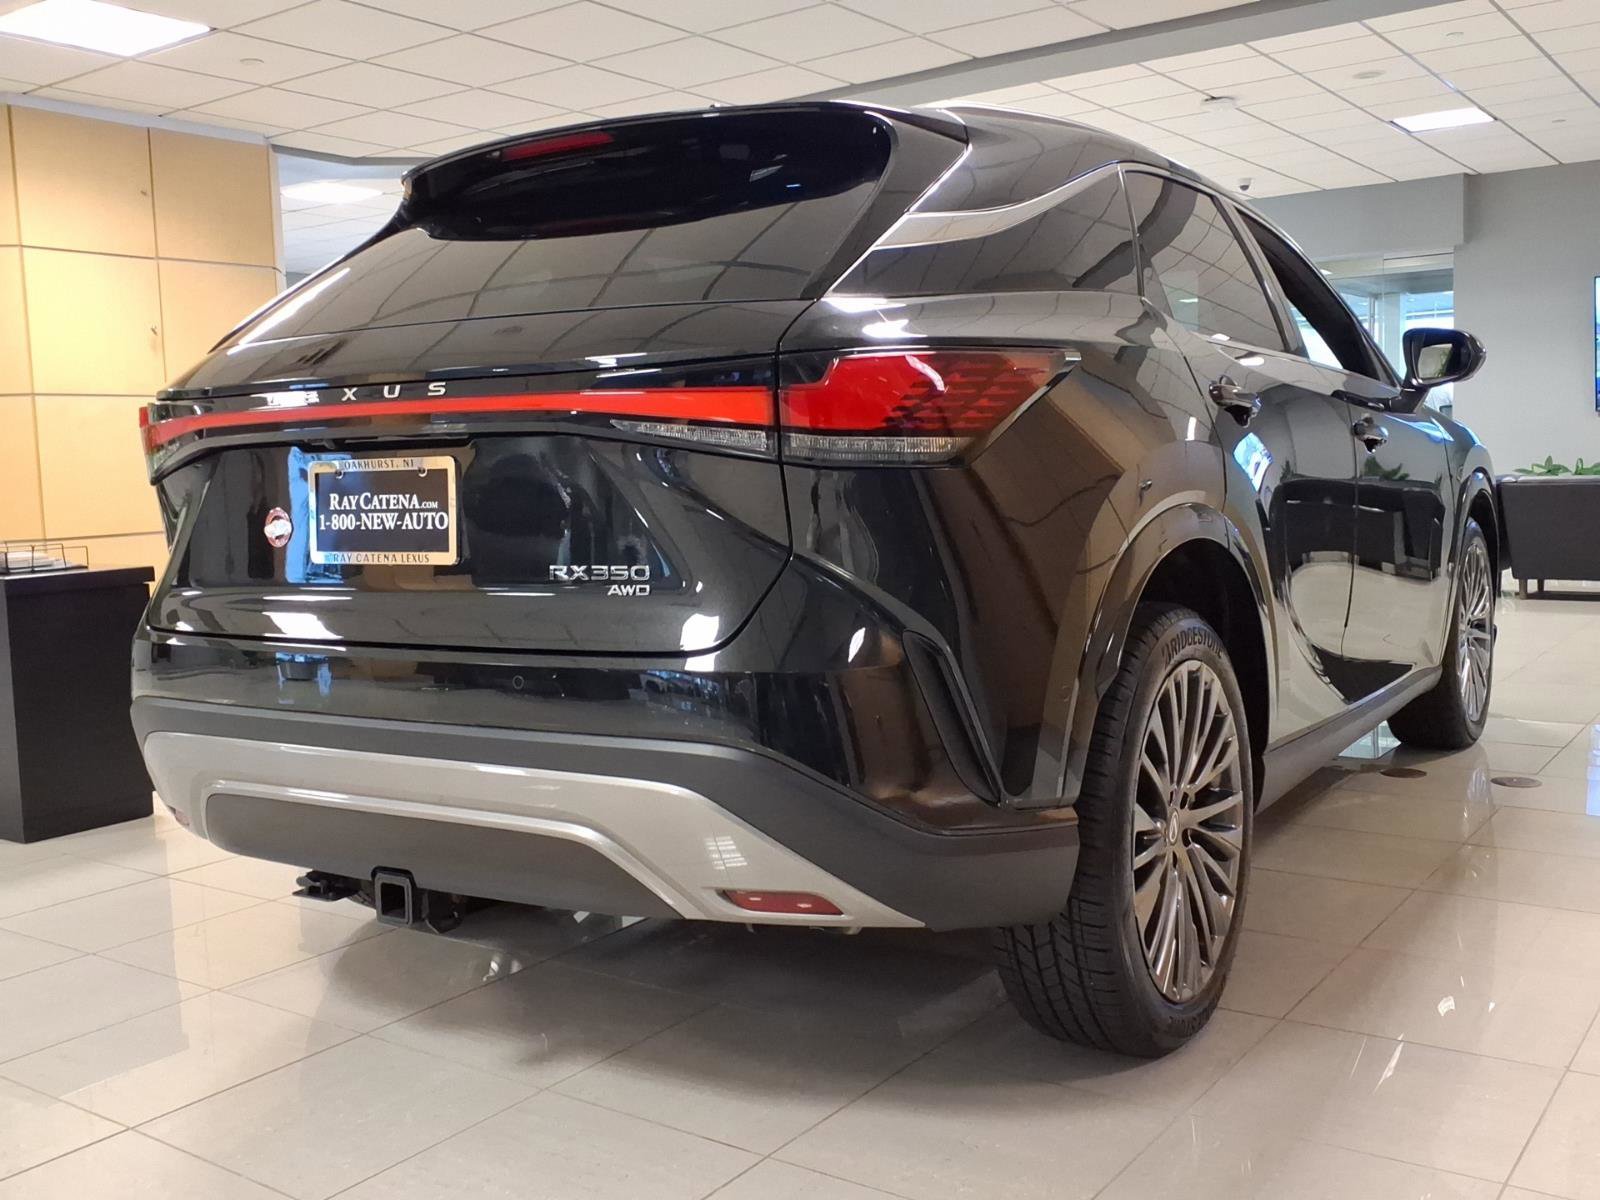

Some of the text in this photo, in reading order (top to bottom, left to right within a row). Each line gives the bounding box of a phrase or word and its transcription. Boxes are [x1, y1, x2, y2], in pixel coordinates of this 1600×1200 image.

[319, 512, 449, 530] 1-800-NEW-AUTO
[333, 553, 430, 563] RAY CATENA LEXUS
[607, 584, 650, 596] AWD
